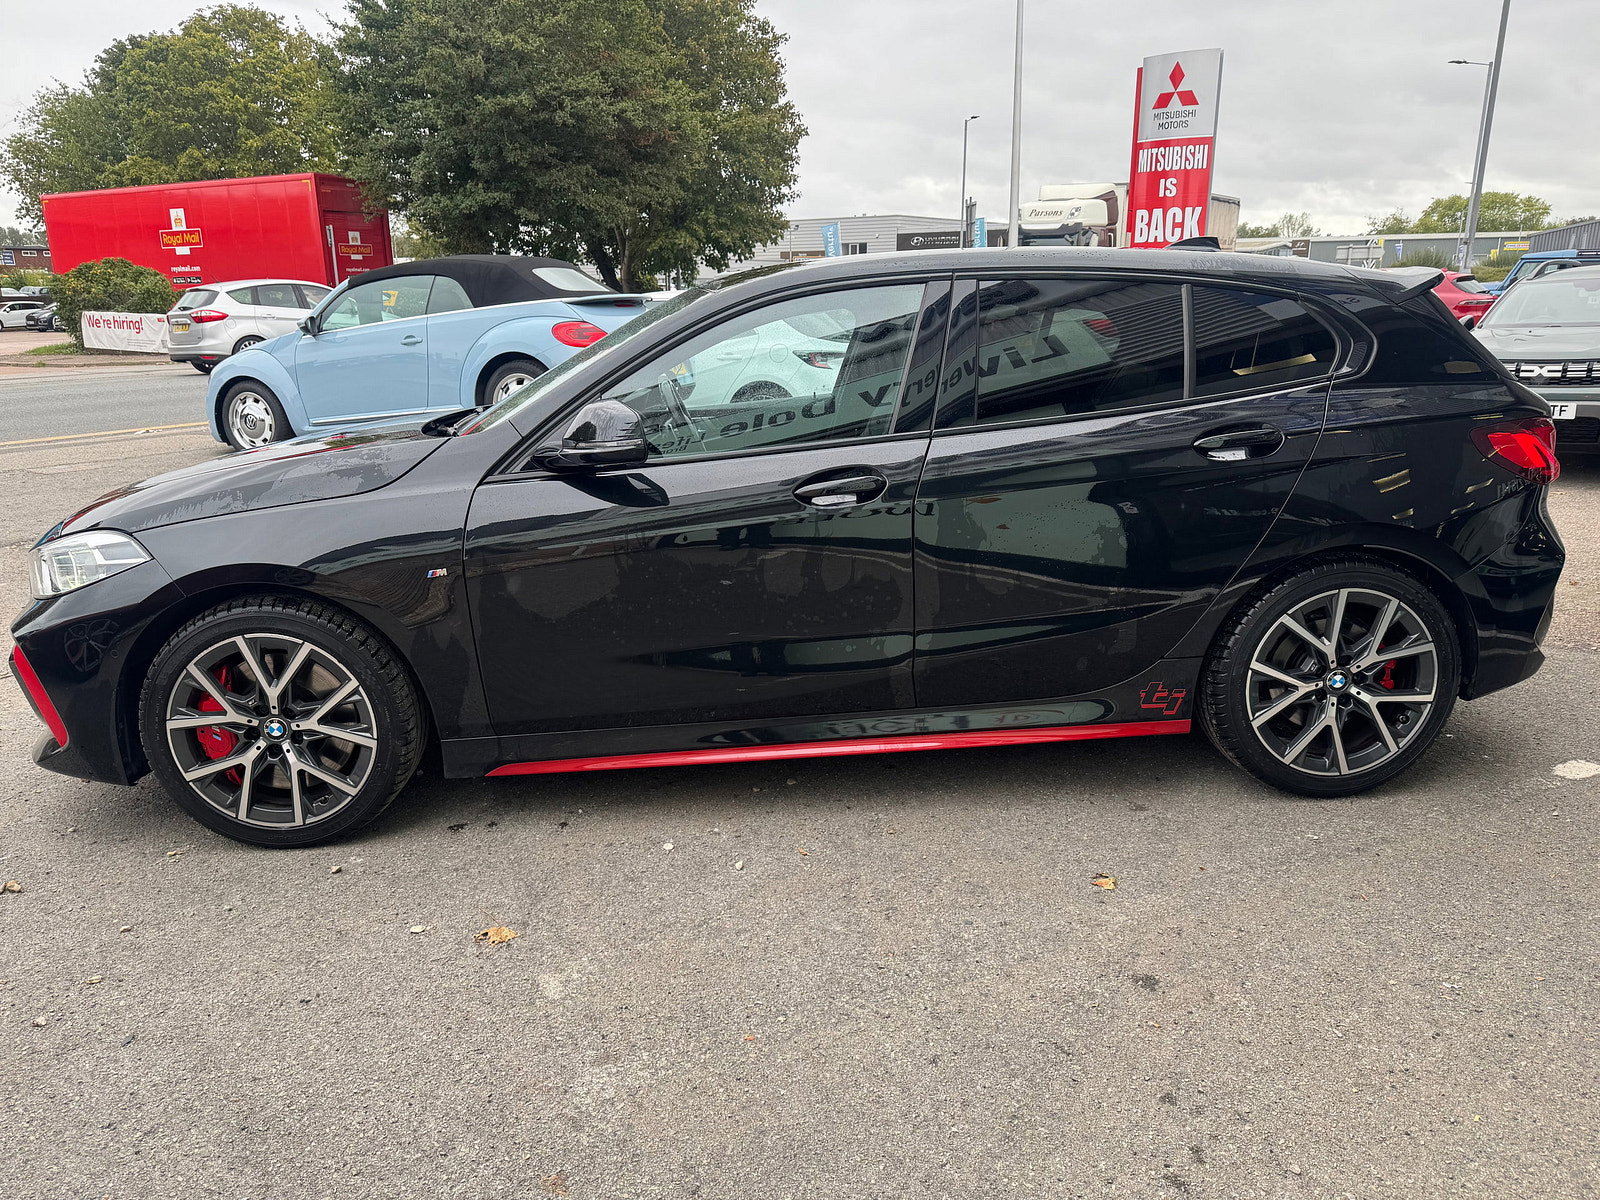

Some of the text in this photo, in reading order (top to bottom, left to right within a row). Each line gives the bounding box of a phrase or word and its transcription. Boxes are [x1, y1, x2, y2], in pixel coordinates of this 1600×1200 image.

[1153, 109, 1197, 121] MITSUBISHI
[1158, 120, 1189, 131] MOTORS
[1138, 144, 1209, 173] MITSUBISHI
[1158, 177, 1178, 198] IS
[1028, 208, 1064, 217] Parsons
[1134, 206, 1203, 244] BACK
[162, 232, 200, 246] Royal Mail
[340, 246, 371, 254] Royal Mail
[86, 315, 144, 334] We're hiring!
